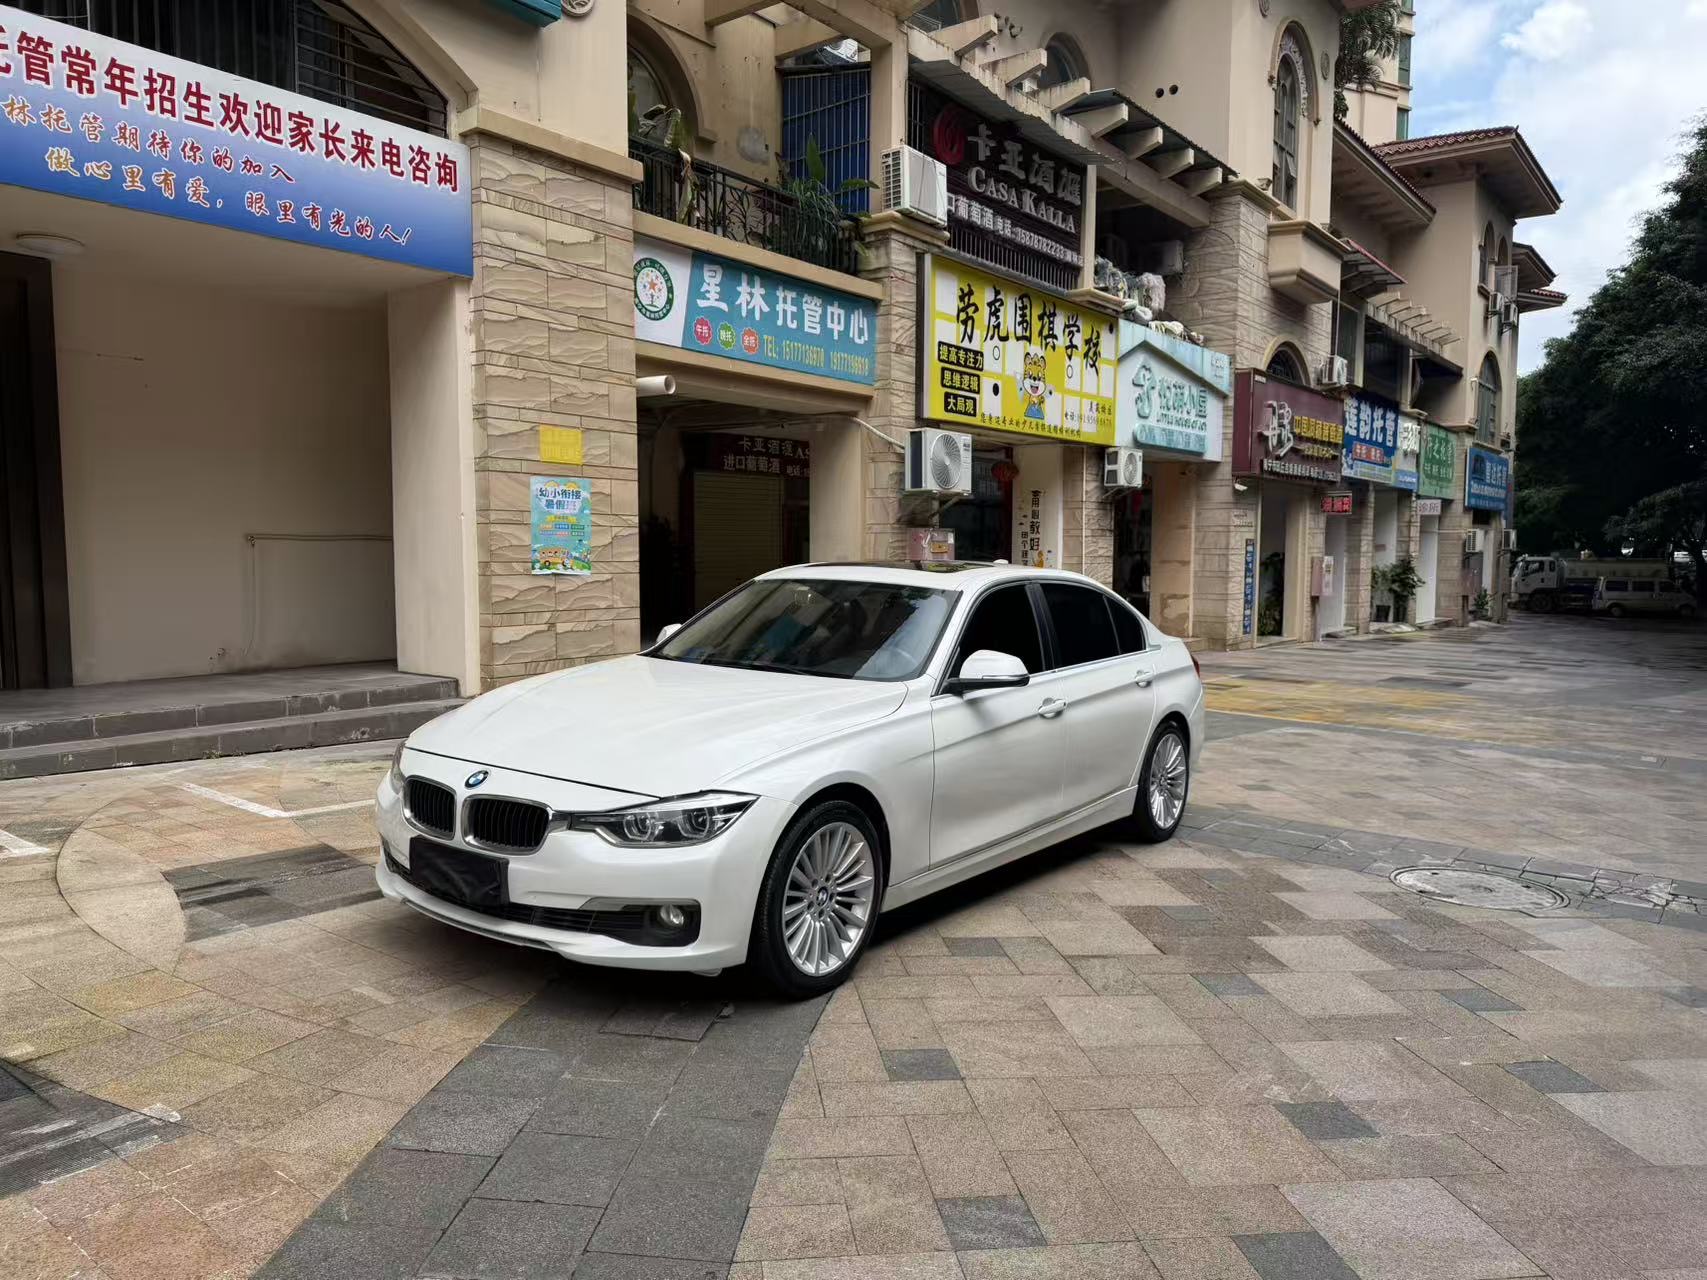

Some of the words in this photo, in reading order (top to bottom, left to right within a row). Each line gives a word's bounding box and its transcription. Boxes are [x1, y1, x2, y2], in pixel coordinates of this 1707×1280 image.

[4, 96, 295, 184] 林托管期待你的加入
[696, 263, 869, 345] 星林托管中心
[956, 283, 1101, 377] 劳虎围棋学校
[939, 343, 983, 370] 提高专注力
[943, 370, 979, 393] 思维逻辑
[947, 396, 975, 415] 大局观
[538, 487, 581, 500] 幼小衔接
